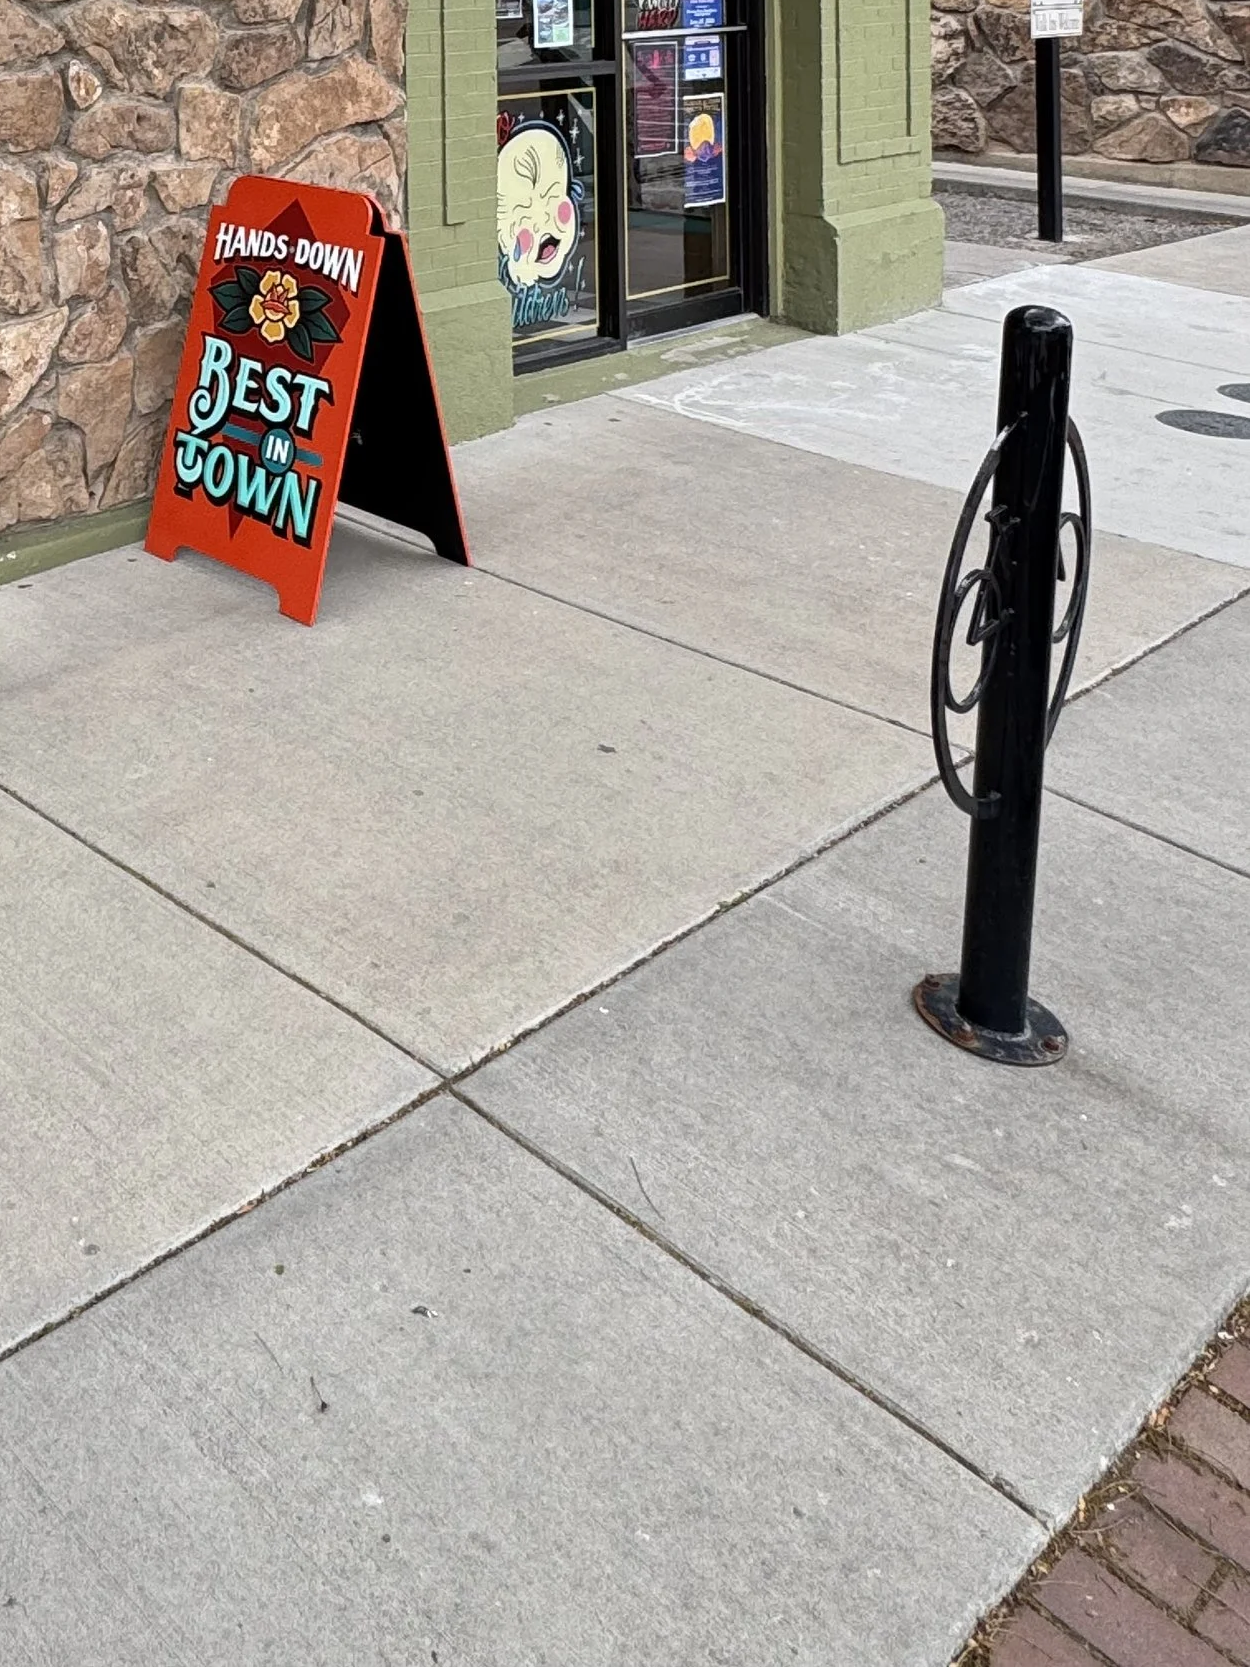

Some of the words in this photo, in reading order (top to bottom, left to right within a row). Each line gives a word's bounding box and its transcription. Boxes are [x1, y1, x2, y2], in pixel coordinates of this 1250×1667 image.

[188, 335, 331, 435] BEST
[175, 432, 318, 540] TOWN
[265, 435, 289, 465] IN
